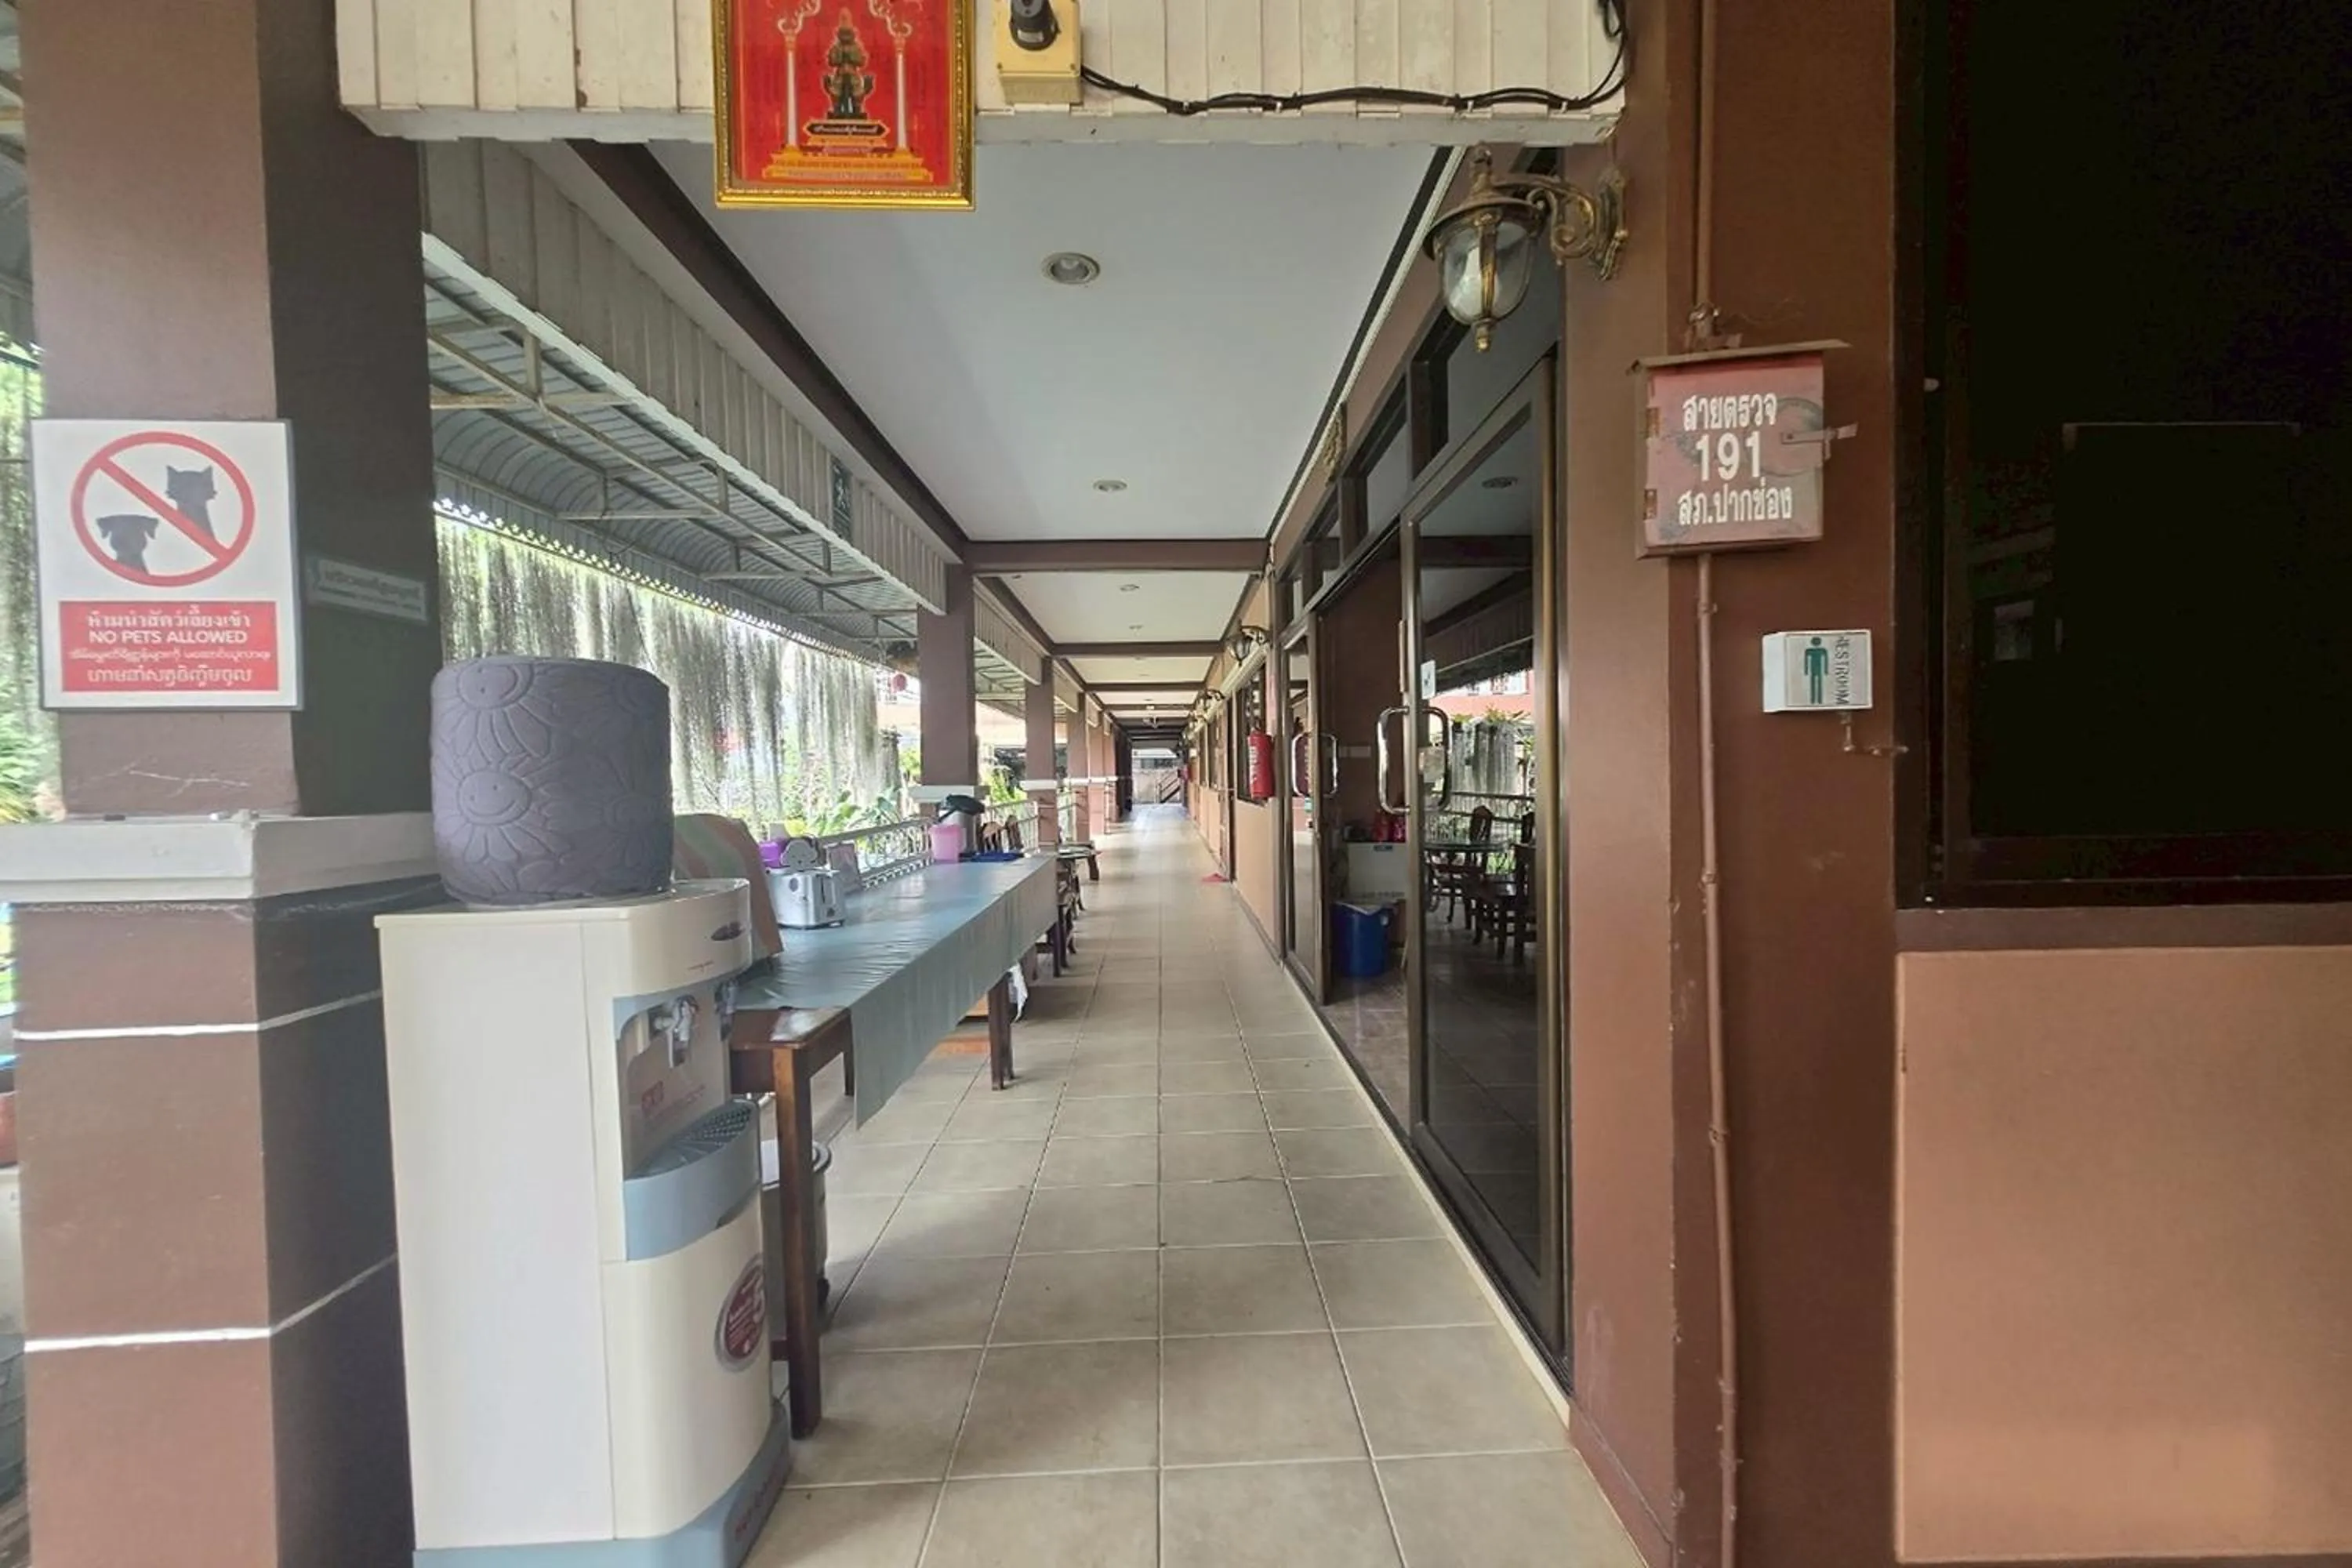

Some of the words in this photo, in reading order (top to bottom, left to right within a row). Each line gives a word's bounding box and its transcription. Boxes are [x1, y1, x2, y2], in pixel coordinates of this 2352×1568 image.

[1682, 394, 1777, 431] สายตรวจ
[1696, 431, 1761, 481] 191
[1678, 476, 1793, 525] สภ.ปากช่อง
[89, 630, 117, 644] NO
[122, 630, 162, 644] PETS
[166, 630, 248, 644] ALLOWED
